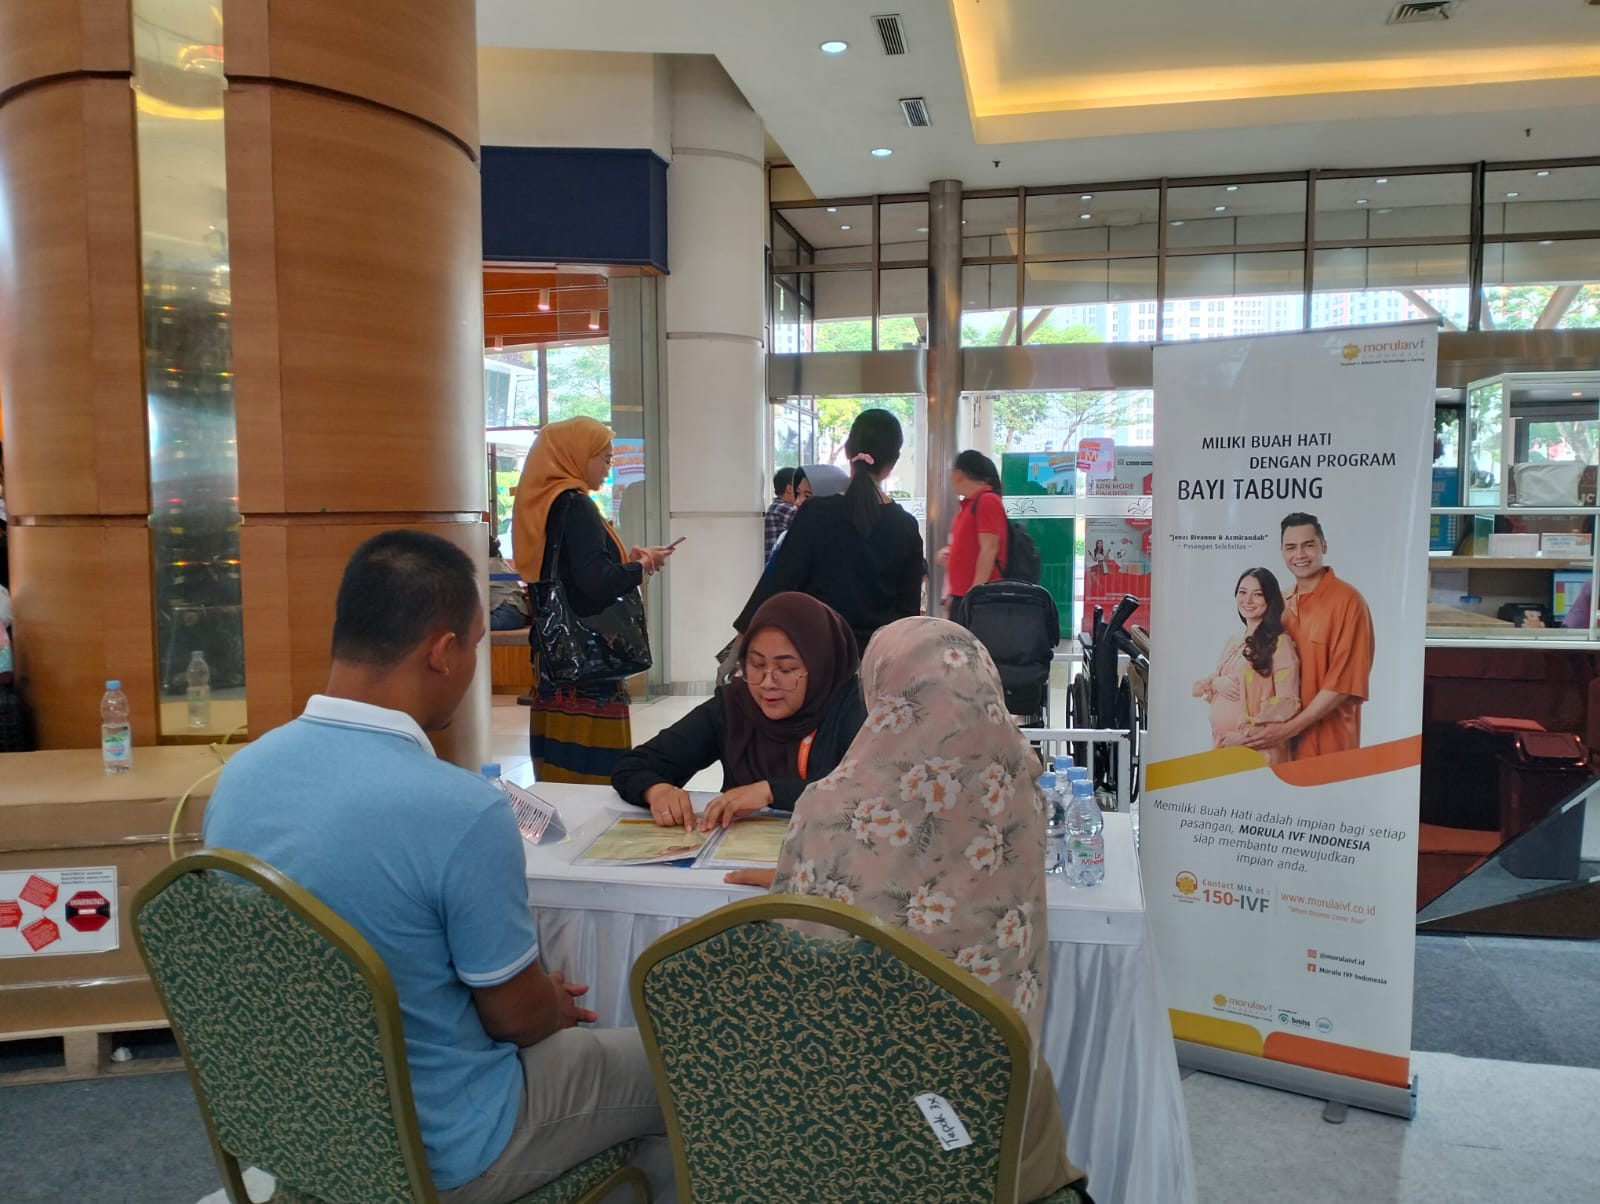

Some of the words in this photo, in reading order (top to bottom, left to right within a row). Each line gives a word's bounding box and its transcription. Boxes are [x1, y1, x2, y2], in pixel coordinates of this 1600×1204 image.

[1363, 338, 1424, 352] morulaivf
[1202, 436, 1246, 450] MILIKI
[1251, 434, 1292, 448] BUAH
[1298, 433, 1332, 446] HATI
[1250, 455, 1311, 469] DENGAN
[1317, 453, 1396, 468] PROGRAM
[1178, 479, 1225, 500] BAYI
[1233, 477, 1323, 500] TABUNG
[1154, 800, 1196, 814] Memiliki
[1200, 805, 1227, 818] Buah
[1230, 808, 1253, 821] Hati
[1256, 812, 1293, 825] adalah
[1296, 816, 1336, 831] impian
[1340, 821, 1365, 837] bagi
[1369, 826, 1406, 842] setiap
[1180, 818, 1234, 834] pasangan,
[1239, 824, 1285, 840] MORULA
[1288, 831, 1306, 842] IVF
[1309, 834, 1370, 851] INDONESIA
[1193, 834, 1215, 846] siap
[1219, 837, 1278, 853] membantu
[1282, 846, 1355, 864] mewujudkan
[1237, 852, 1274, 867] impian
[1277, 860, 1308, 872] anda.
[1202, 879, 1234, 889] Contact
[1237, 884, 1253, 893] MIA
[1203, 889, 1270, 913] 150-IVF
[1281, 892, 1376, 916] www.morulaivf.co.id
[1319, 967, 1342, 977] Morula
[1355, 973, 1387, 985] Indonesia
